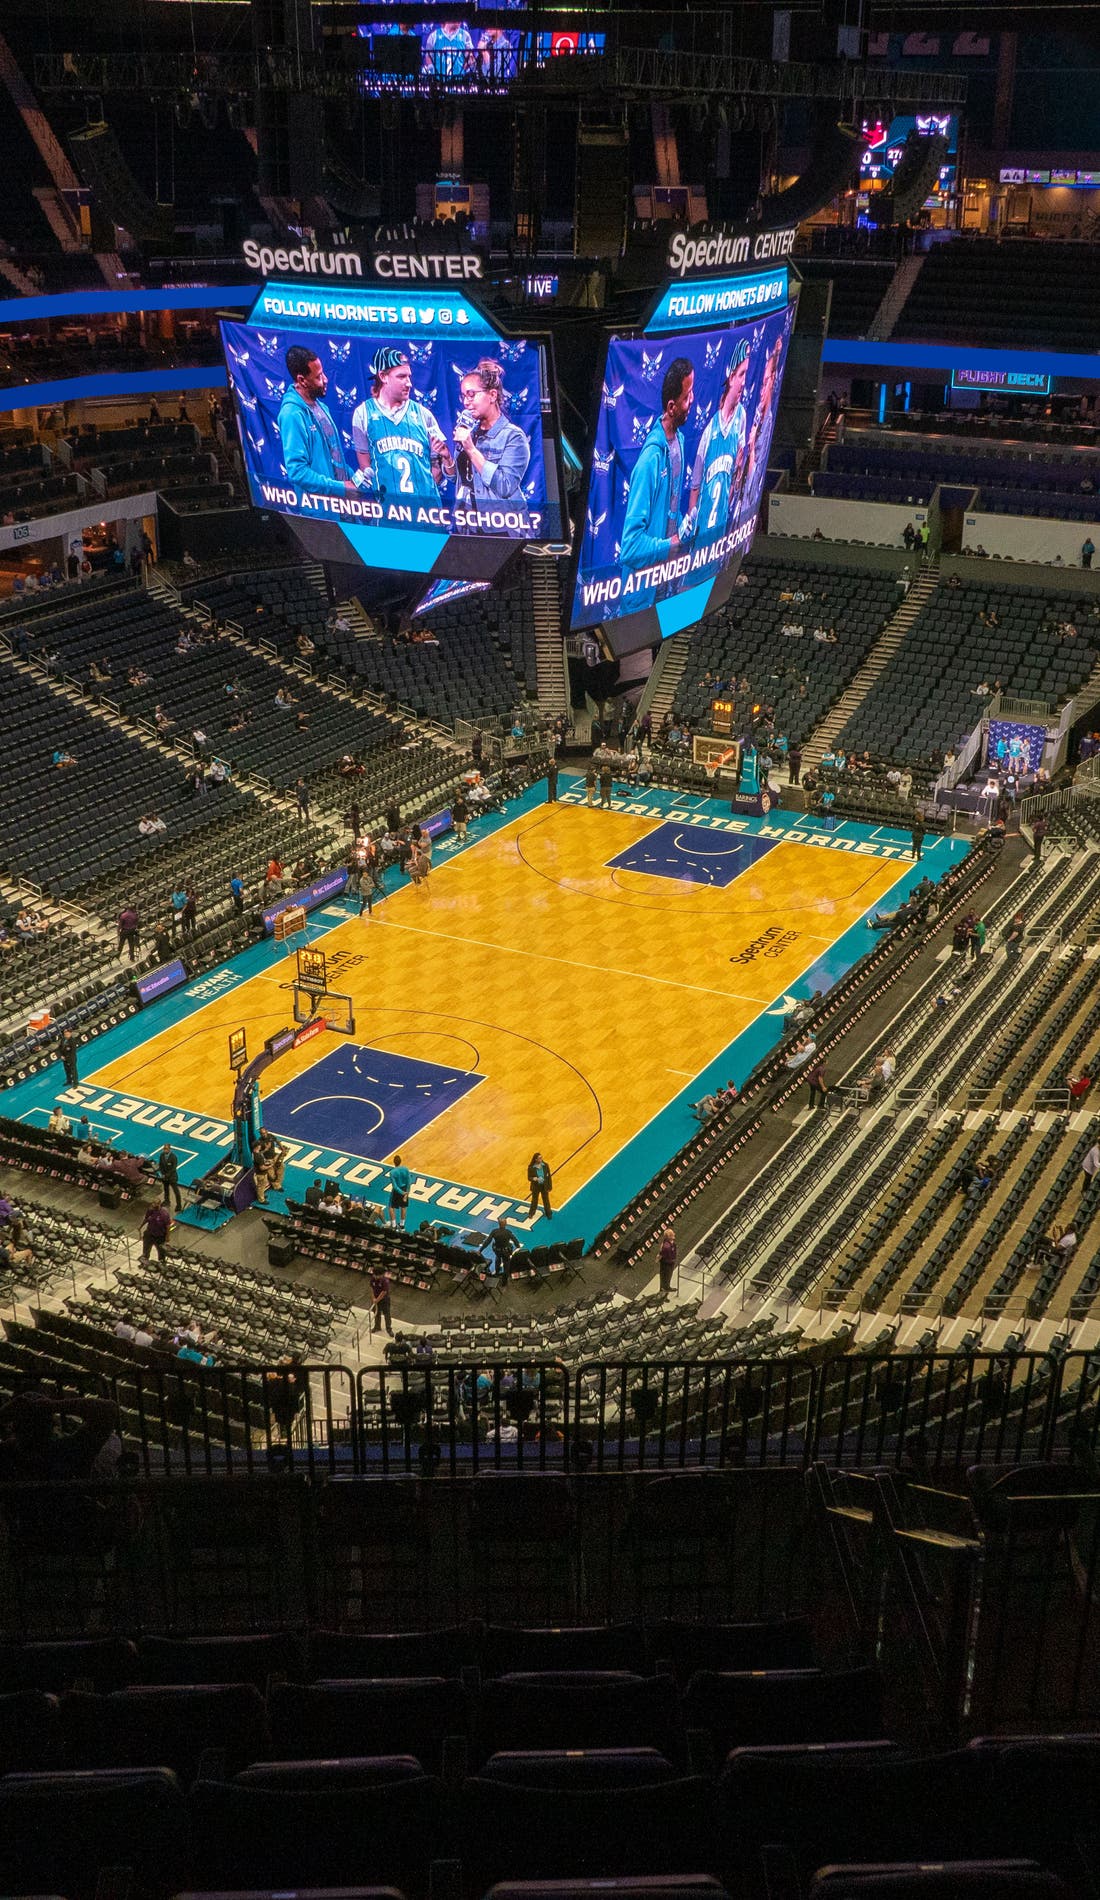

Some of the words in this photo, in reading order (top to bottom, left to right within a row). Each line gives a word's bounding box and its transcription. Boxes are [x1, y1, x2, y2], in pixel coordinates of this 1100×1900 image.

[242, 240, 363, 276] Spectrum
[374, 254, 484, 279] CENTER
[670, 232, 750, 277] Spectrum
[754, 229, 796, 260] CENTER
[263, 297, 321, 319] FOLLOW
[324, 303, 398, 324] HORNETS
[668, 294, 716, 317] FOLLOW
[715, 286, 757, 311] HORNETS
[1007, 373, 1045, 387] DECK
[376, 436, 424, 458] CHARLOTTE
[397, 457, 414, 493] 2
[262, 485, 298, 506] WHO
[300, 493, 384, 519] ATTENDED
[387, 505, 412, 522] AN
[416, 508, 451, 525] ACC
[455, 510, 542, 530] SCHOOL?
[707, 481, 722, 528] 2
[583, 577, 622, 606] WHO
[623, 555, 692, 596] ATTENDED
[691, 545, 709, 569] AN
[707, 538, 725, 561] ACC
[726, 514, 757, 551] SCHOOL?
[729, 927, 784, 965] Spectrum
[763, 930, 802, 958] CENTER
[184, 968, 234, 997] NOVANT
[196, 973, 243, 1000] HEALTH
